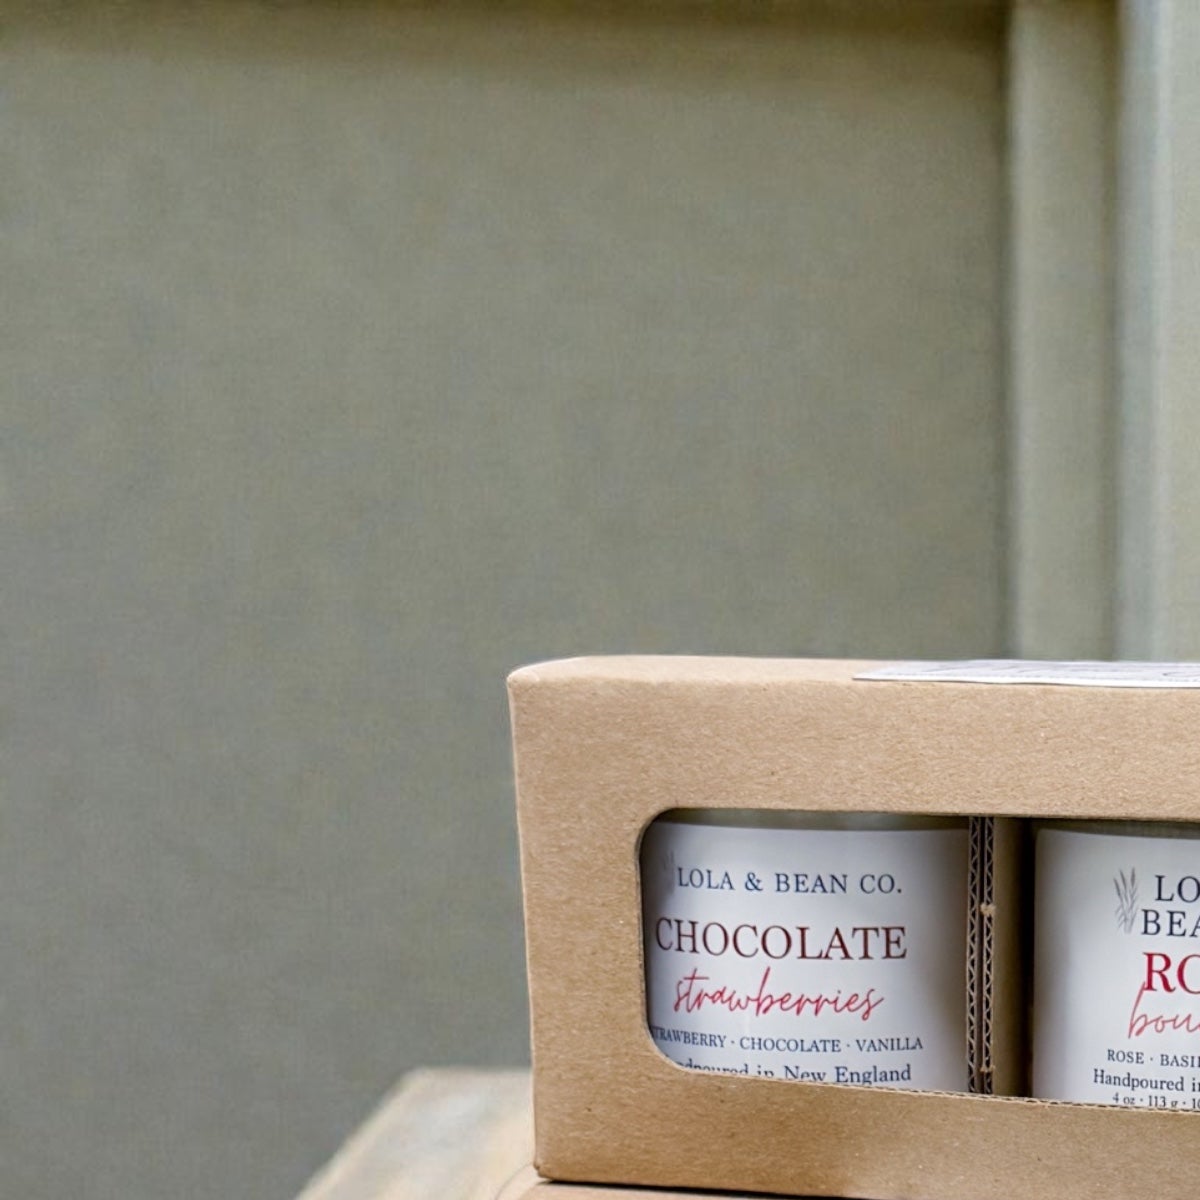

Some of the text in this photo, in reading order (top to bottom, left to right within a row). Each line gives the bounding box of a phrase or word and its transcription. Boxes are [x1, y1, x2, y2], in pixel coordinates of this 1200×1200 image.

[677, 867, 902, 894] LOLA & BEAN CO.
[655, 916, 908, 960] CHOCOLATE
[673, 966, 884, 1021] strawberries
[739, 1036, 842, 1053] CHOCOLATE
[856, 1037, 923, 1052] VANILLA
[1106, 1049, 1145, 1065] ROSE
[784, 1065, 827, 1082] New
[835, 1063, 912, 1085] England
[1093, 1068, 1185, 1092] Handpoured
[1112, 1092, 1120, 1104] 4
[1123, 1096, 1136, 1105] oz
[1148, 1095, 1167, 1108] 113
